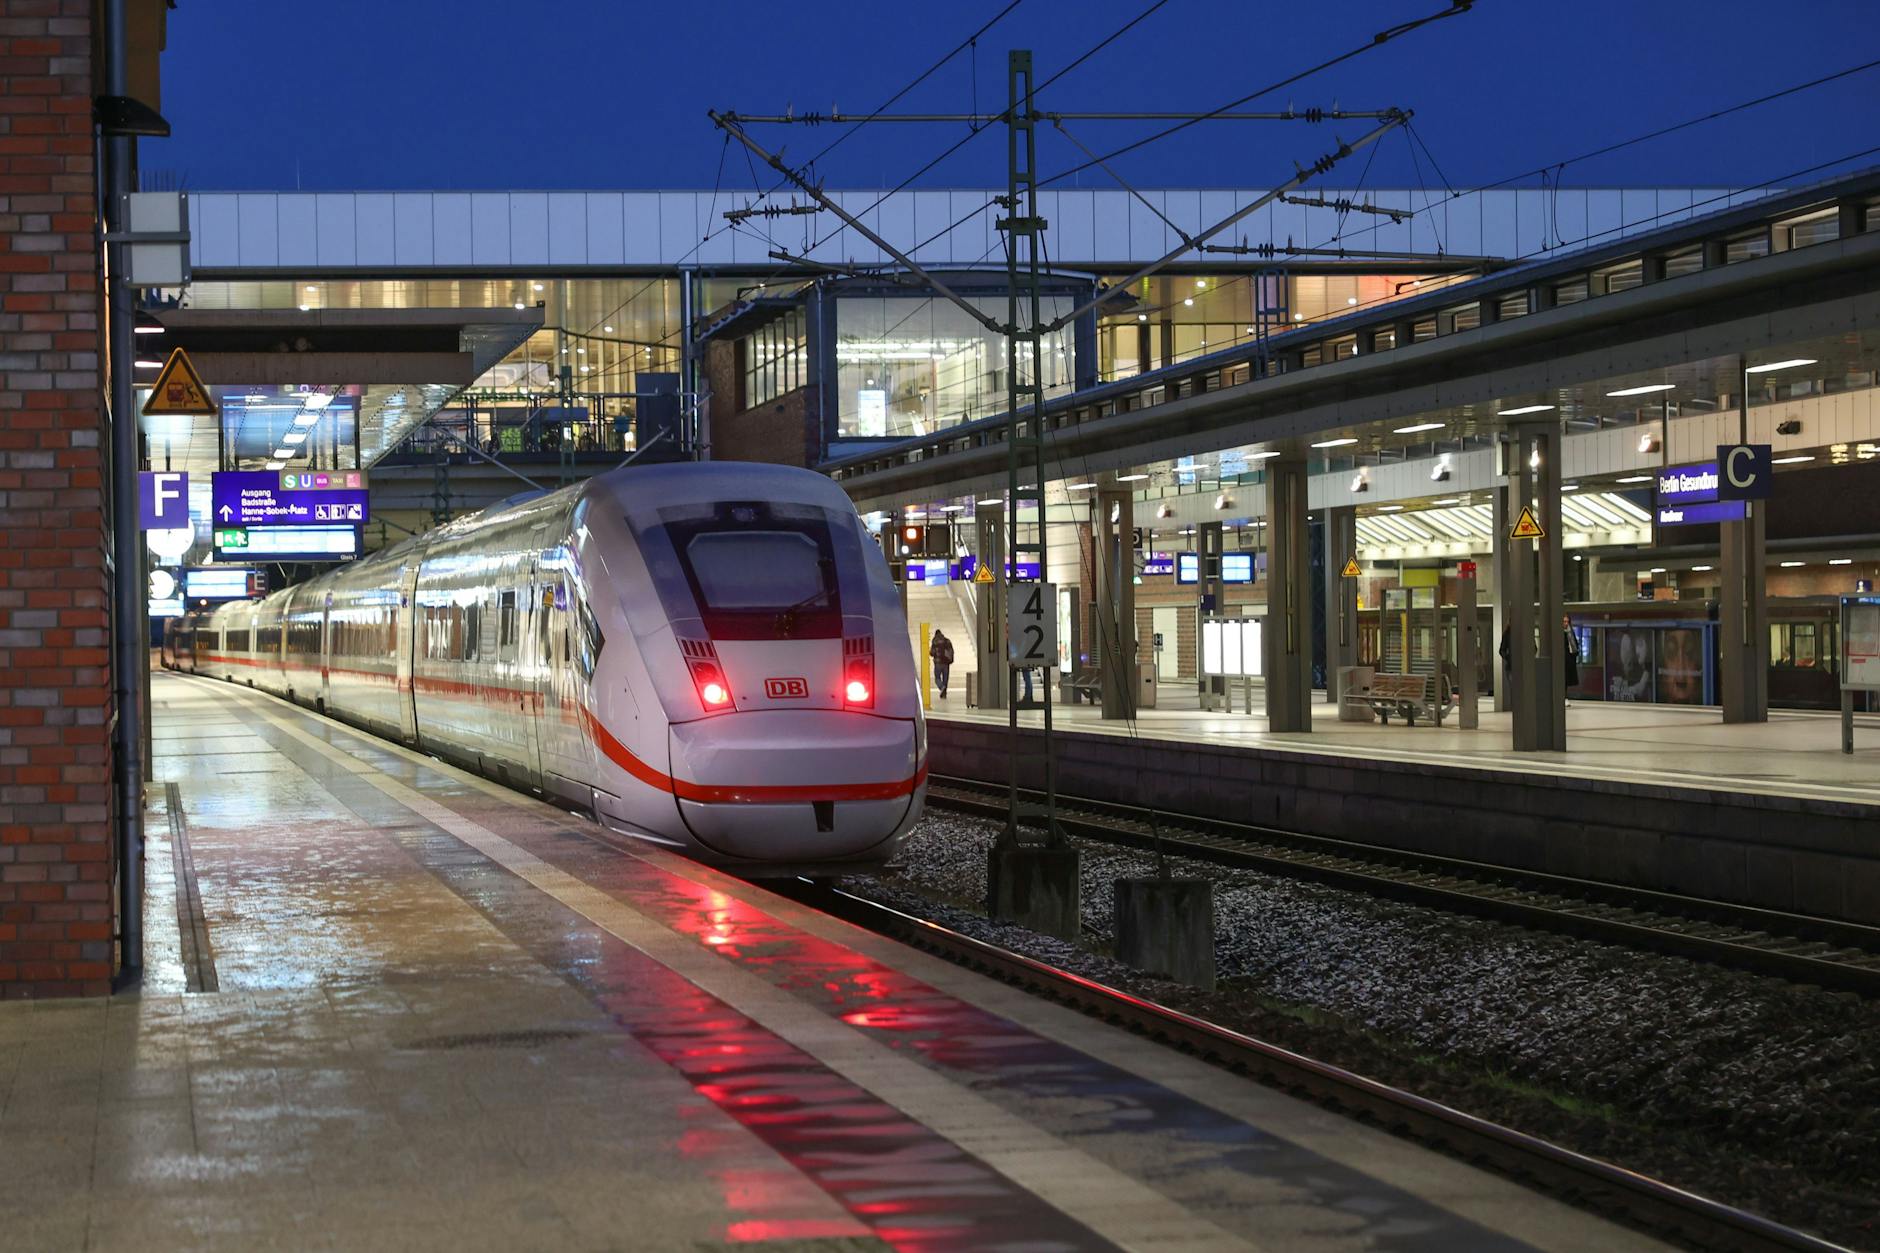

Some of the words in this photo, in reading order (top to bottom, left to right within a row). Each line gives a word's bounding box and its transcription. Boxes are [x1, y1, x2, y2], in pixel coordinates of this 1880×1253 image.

[1727, 446, 1756, 488] C
[284, 474, 296, 489] S
[301, 474, 311, 488] U
[1660, 475, 1680, 494] Berlin
[154, 473, 181, 517] F
[241, 489, 272, 498] Ausgang
[241, 498, 277, 507] Badstraße
[241, 506, 308, 516] Hanne-Sobek-Platz
[254, 572, 266, 591] E
[1022, 586, 1044, 620] 4
[1023, 624, 1045, 659] 2
[769, 680, 804, 696] DB
